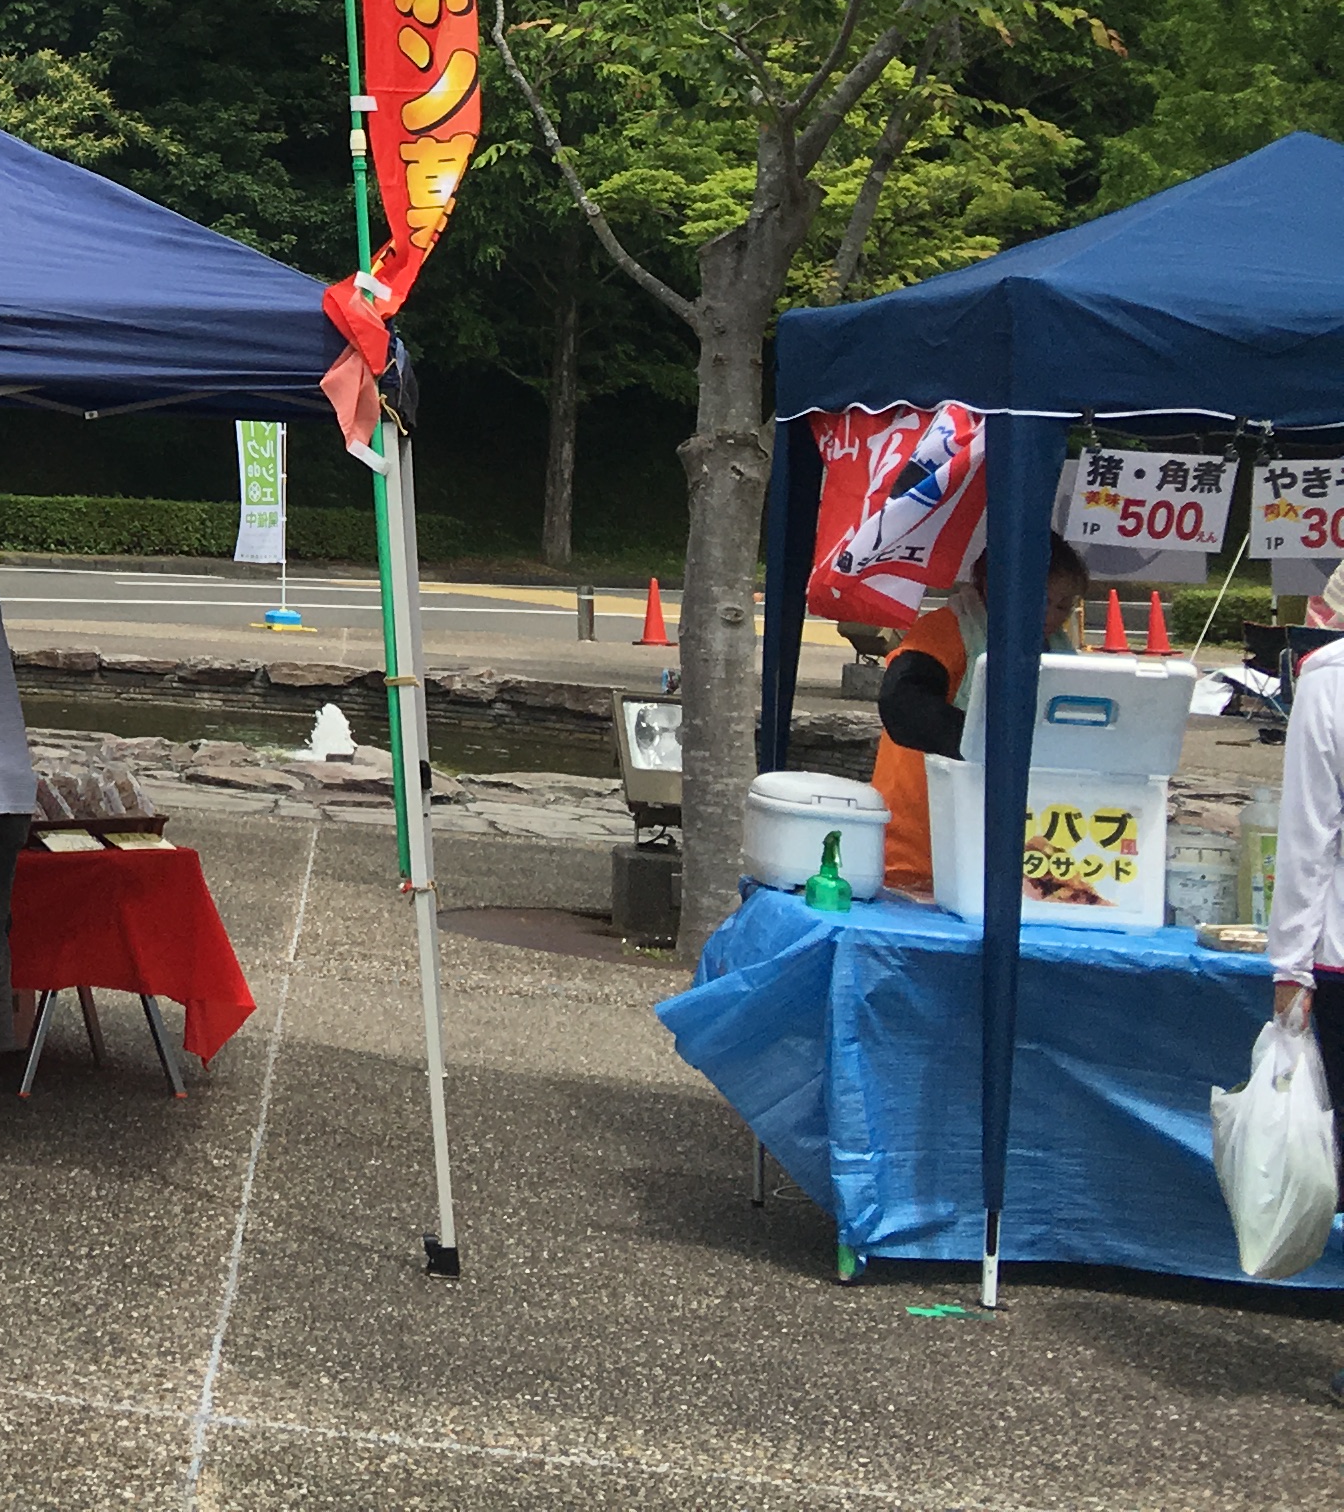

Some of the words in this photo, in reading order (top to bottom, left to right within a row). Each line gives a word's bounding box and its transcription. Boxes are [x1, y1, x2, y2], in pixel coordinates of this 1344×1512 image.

[1086, 455, 1226, 494] 猪・角煮
[1263, 467, 1344, 499] やき
[1085, 490, 1120, 507] 美味
[1082, 522, 1101, 536] 1P
[1265, 536, 1285, 551] 1P
[1026, 810, 1133, 849] バブ
